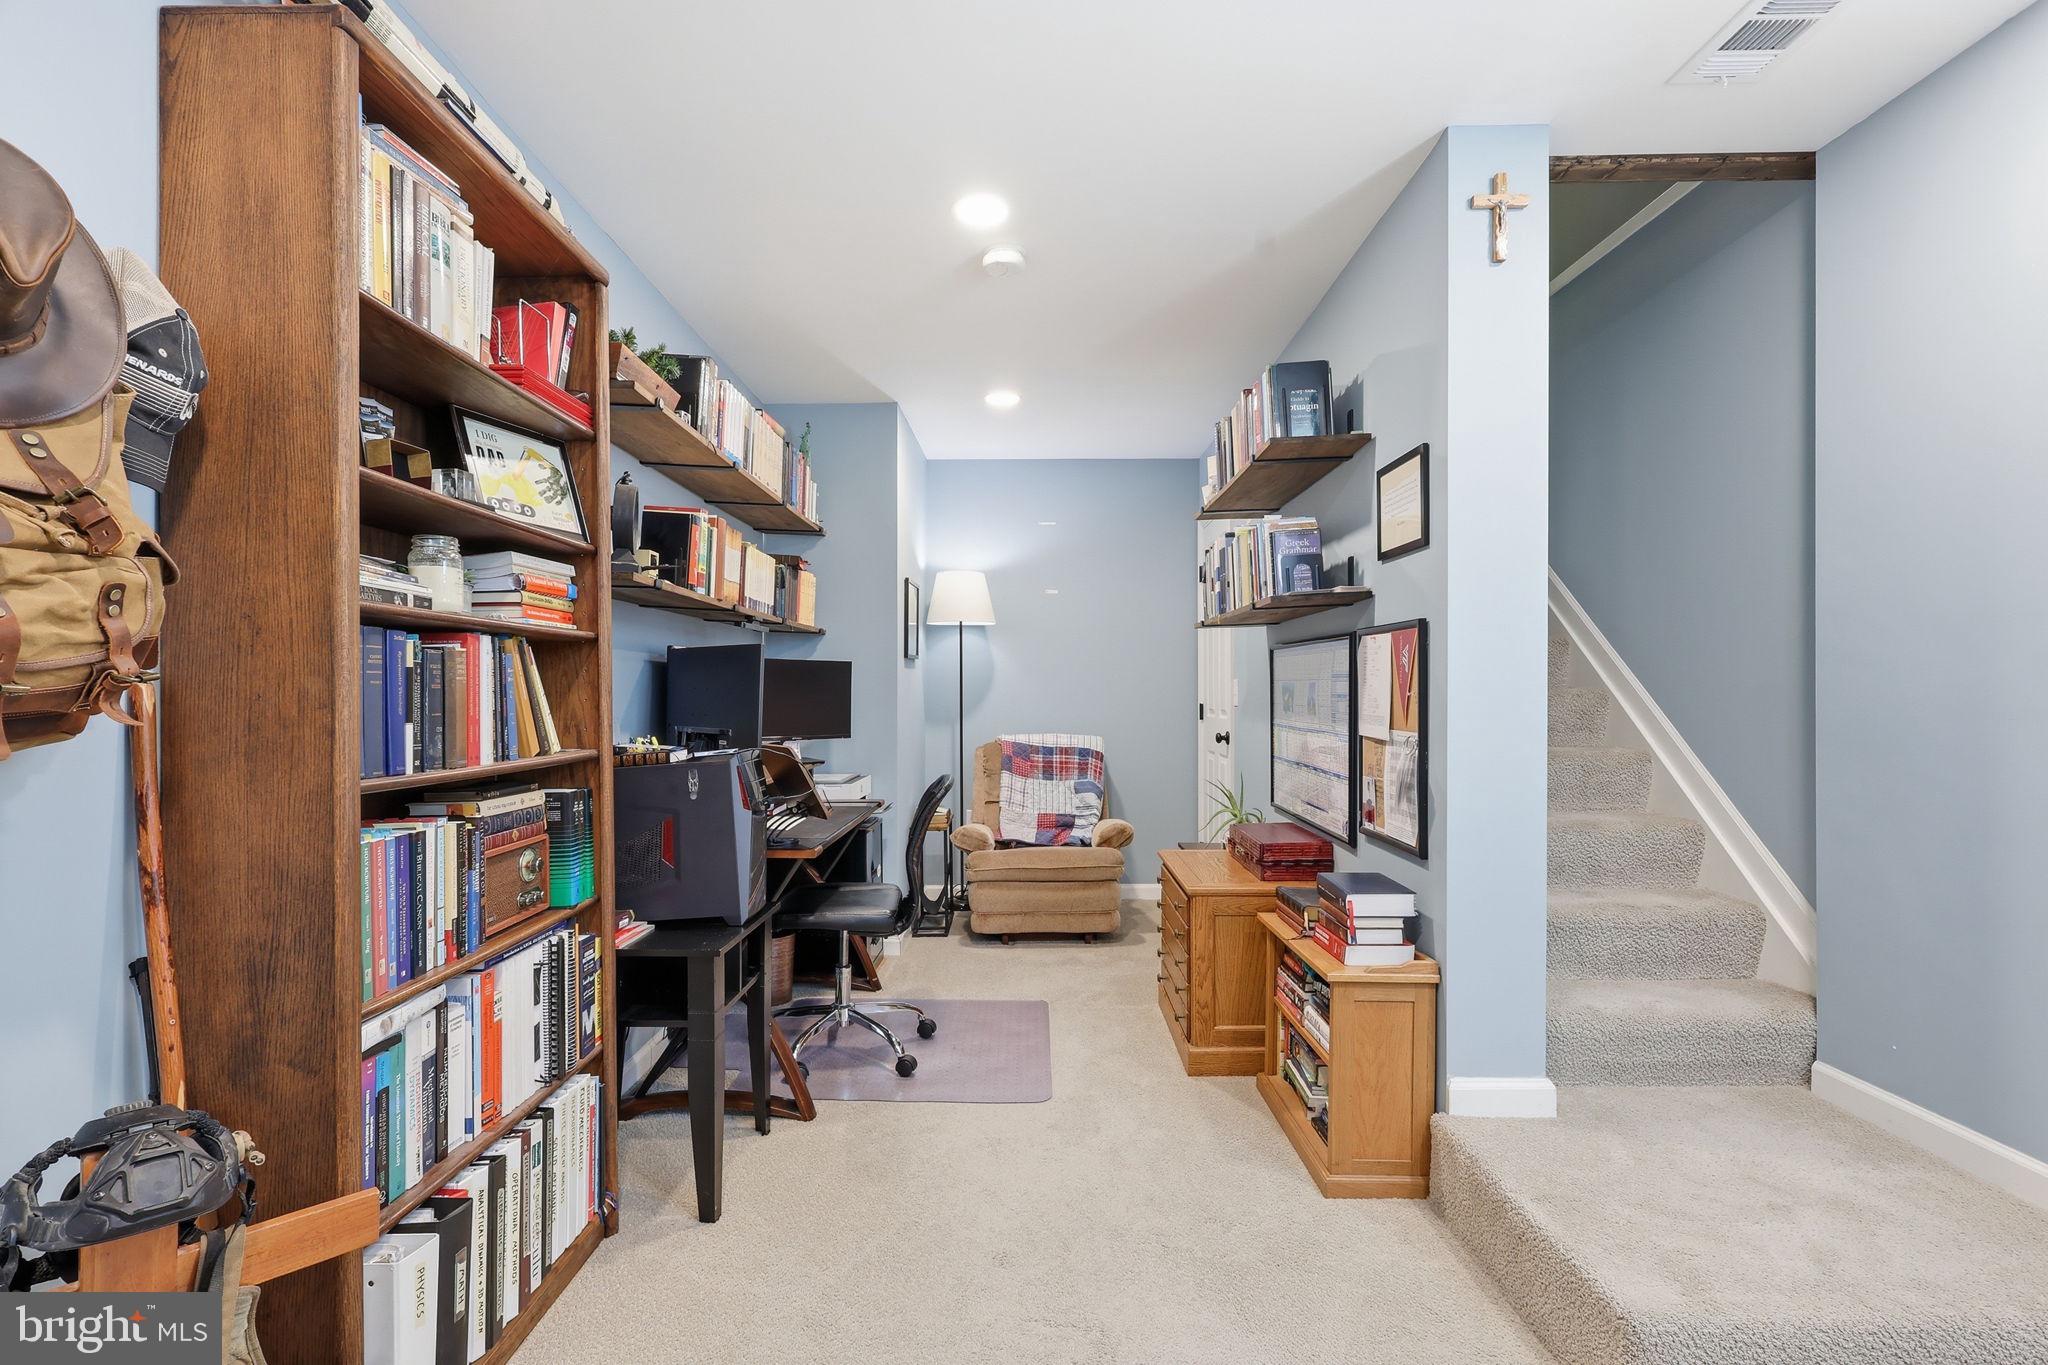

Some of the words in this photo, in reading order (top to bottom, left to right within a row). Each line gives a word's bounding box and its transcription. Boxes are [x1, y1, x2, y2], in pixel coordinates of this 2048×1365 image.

[422, 203, 430, 258] BIBLICAL
[125, 353, 184, 386] ENARDS
[481, 431, 498, 443] DIG
[1279, 547, 1318, 555] Grammar
[1286, 538, 1310, 547] Greek
[416, 854, 424, 894] BIBLICAL
[416, 895, 424, 930] CANON
[427, 1066, 436, 1124] Mechanical
[552, 1137, 560, 1166] SOLID
[477, 1189, 486, 1240] ANALYTICAL
[511, 1172, 520, 1235] OPERATIONAL
[477, 1242, 485, 1278] DYNAMICS
[511, 1241, 519, 1286] METHODS
[415, 1266, 426, 1320] PHYSICS
[457, 1269, 466, 1306] MATH
[477, 1301, 485, 1334] MOTION
